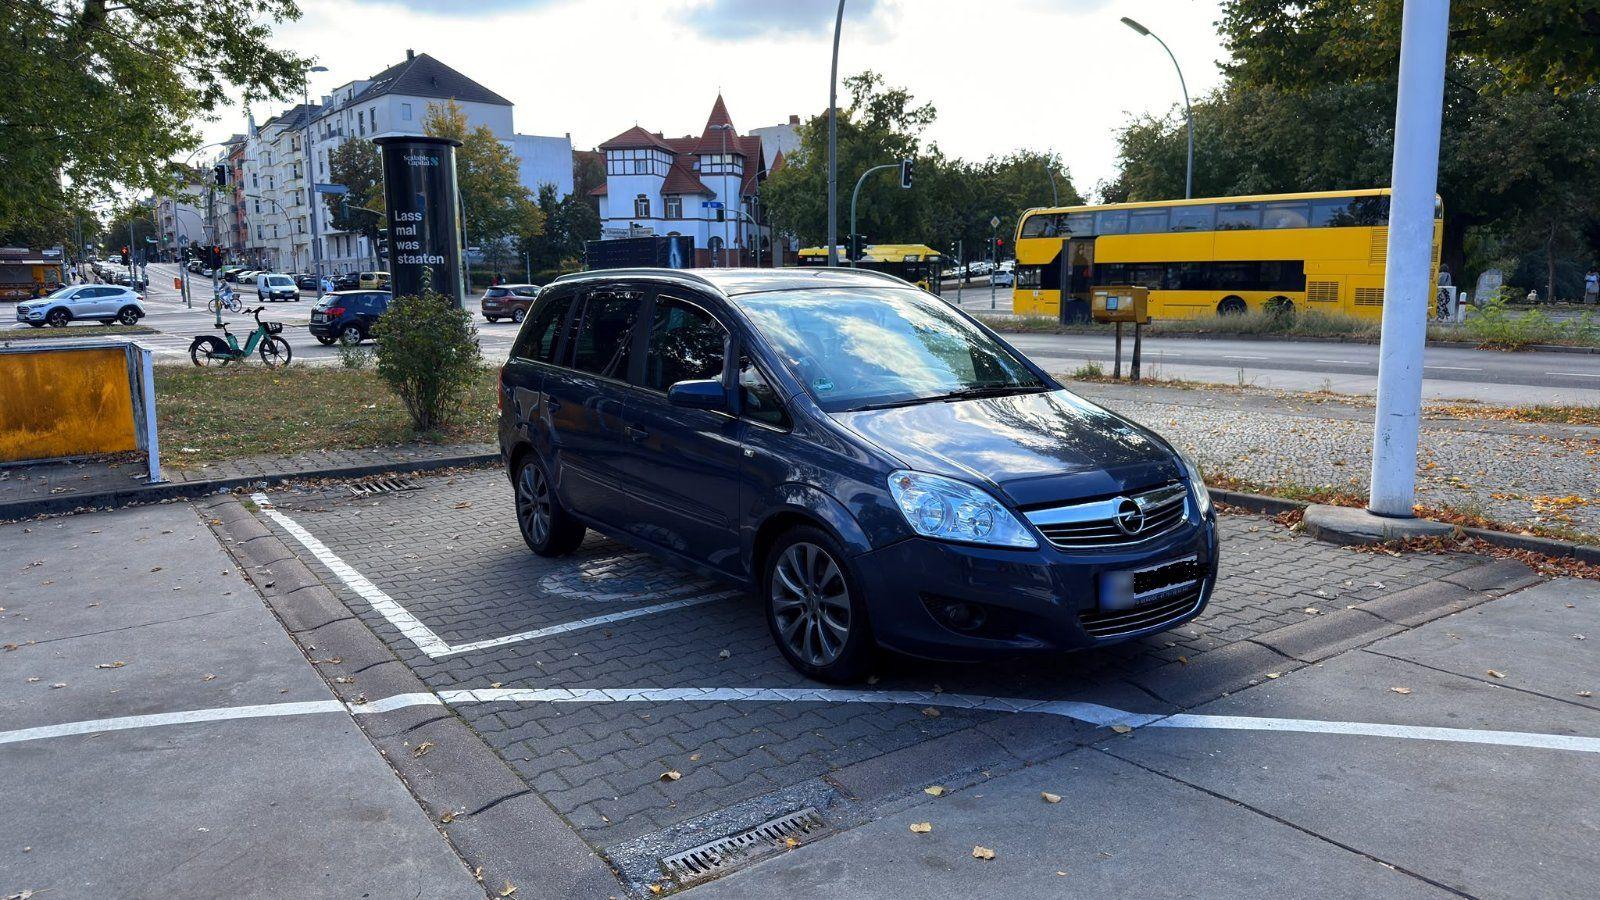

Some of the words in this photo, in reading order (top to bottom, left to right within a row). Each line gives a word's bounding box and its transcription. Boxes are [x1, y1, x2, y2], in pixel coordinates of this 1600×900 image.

[394, 210, 422, 222] Lass
[396, 225, 417, 236] mal
[396, 240, 419, 250] was
[397, 253, 445, 265] staaten
